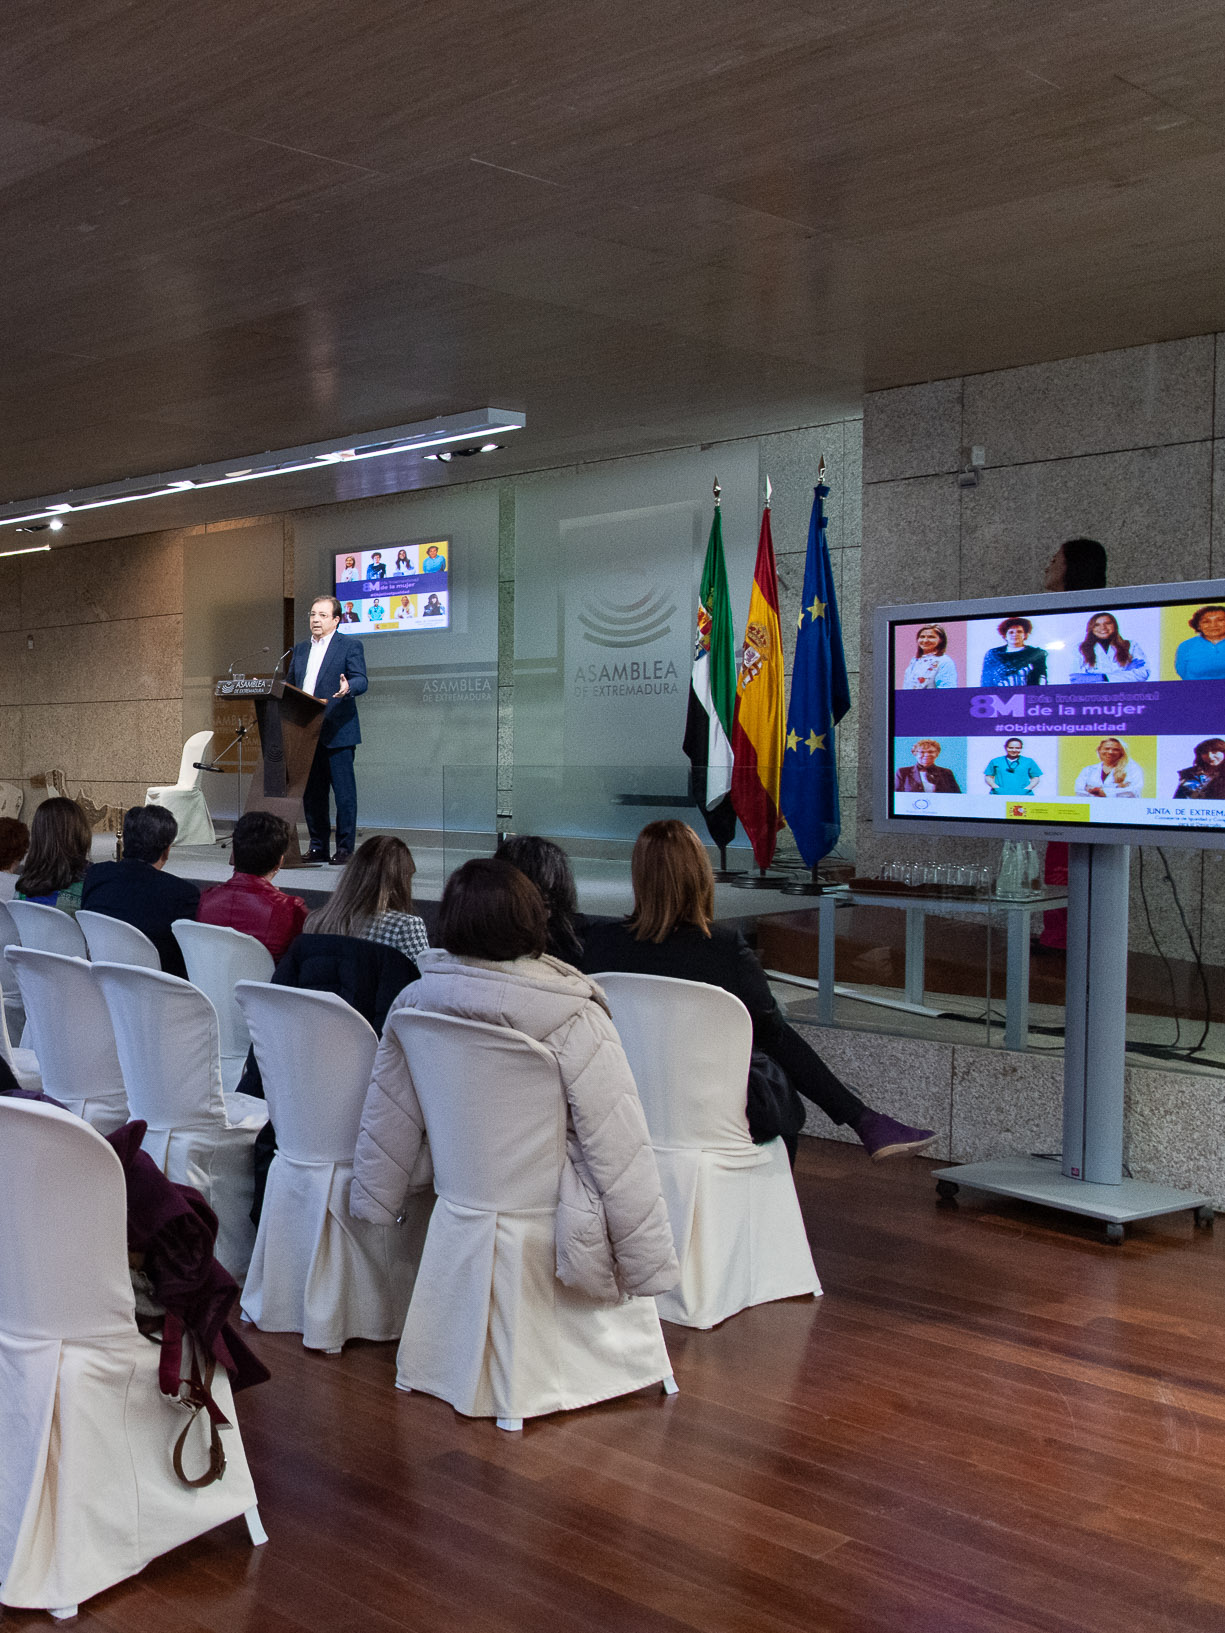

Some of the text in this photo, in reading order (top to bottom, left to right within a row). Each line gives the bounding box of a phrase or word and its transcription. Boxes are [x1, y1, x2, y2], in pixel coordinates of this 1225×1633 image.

[574, 661, 678, 682] ASAMBLEA
[236, 680, 266, 688] ASAMBLEA
[423, 678, 491, 692] ASAMBLEA
[593, 683, 679, 696] EXTREMADURA
[1056, 691, 1160, 703] internacional
[969, 694, 1026, 718] 8M
[1027, 702, 1146, 717] de la mujer
[995, 722, 1127, 733] #ObjetivoIgualdad
